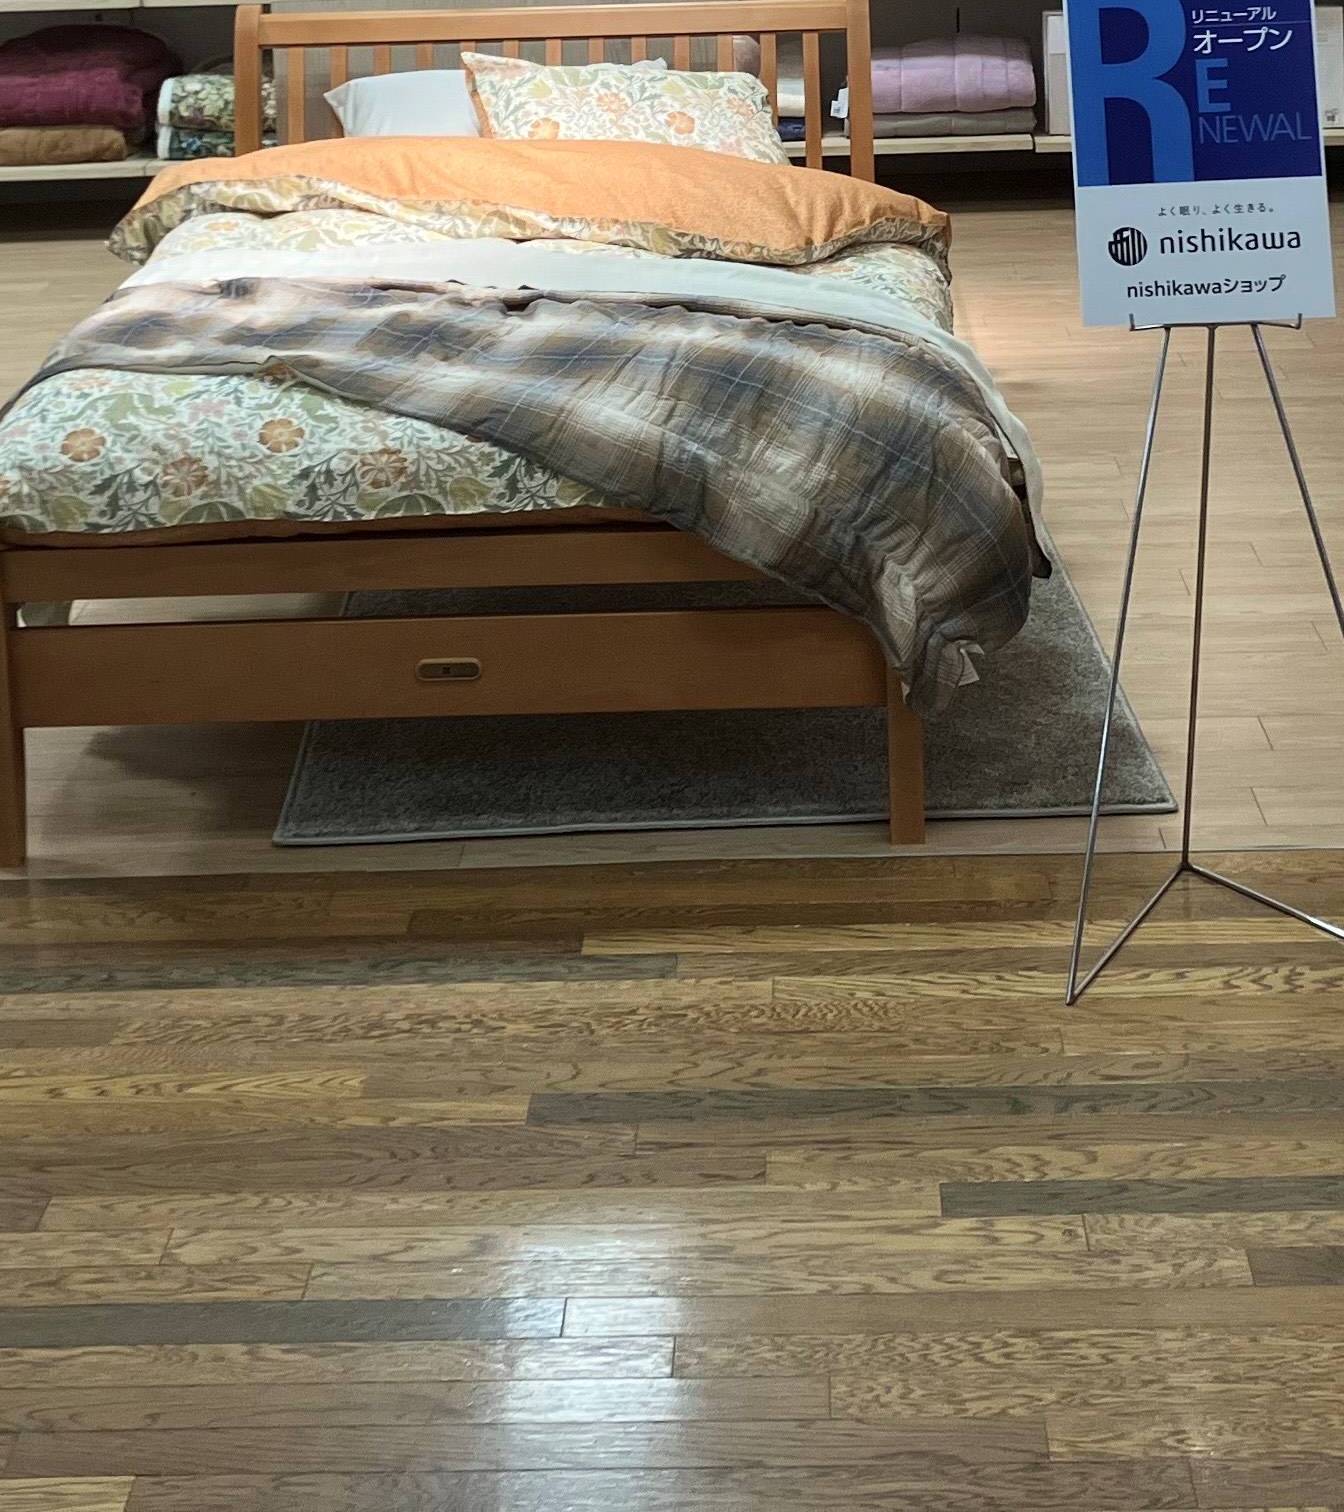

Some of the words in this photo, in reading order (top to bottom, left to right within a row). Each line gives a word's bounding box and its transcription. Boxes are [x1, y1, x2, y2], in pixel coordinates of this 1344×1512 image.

[1191, 6, 1277, 25] リニューアル
[1192, 28, 1294, 55] オープン
[1158, 202, 1275, 217] よく眠り、よく生きる。
[1159, 228, 1302, 255] nishikawa
[1126, 274, 1287, 299] nishikawaショップ
